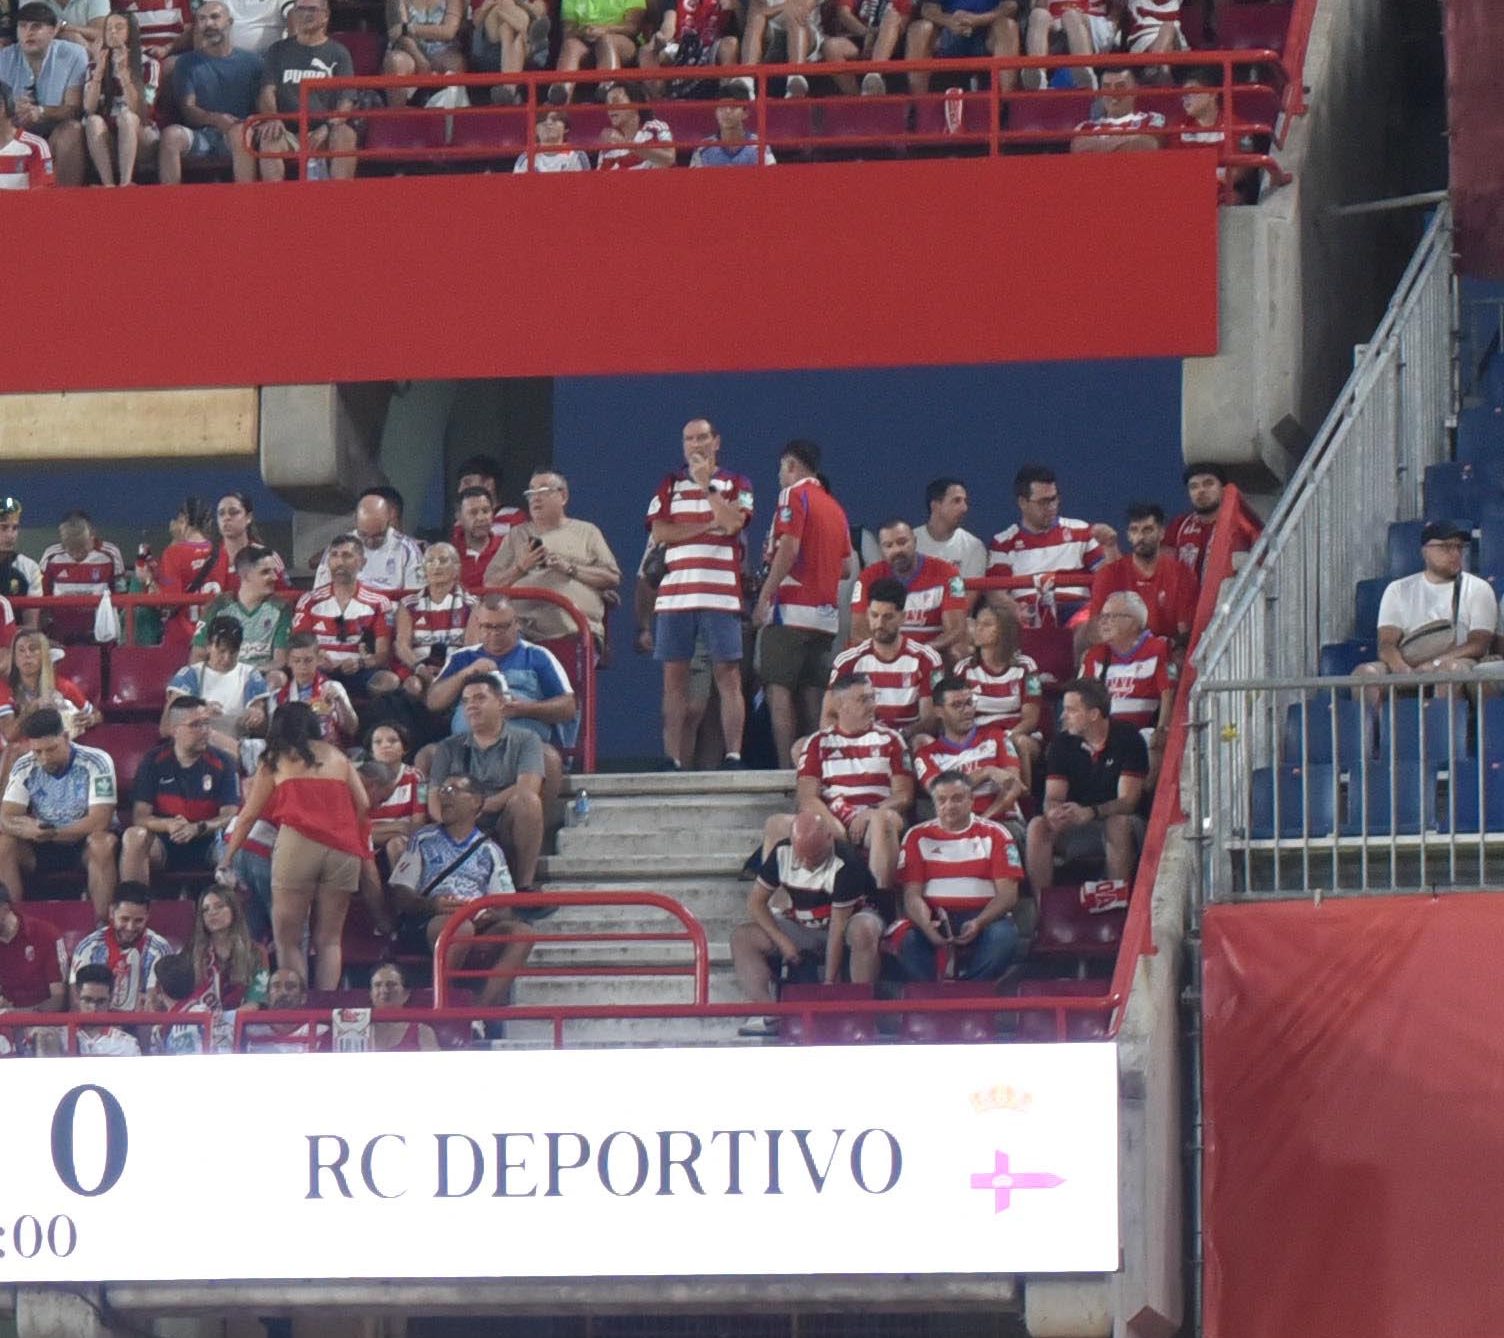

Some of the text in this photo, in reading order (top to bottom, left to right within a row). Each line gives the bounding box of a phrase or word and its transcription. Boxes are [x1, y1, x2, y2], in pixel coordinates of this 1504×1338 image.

[49, 1083, 129, 1199] 0
[304, 1126, 904, 1200] RC DEPORTIVO
